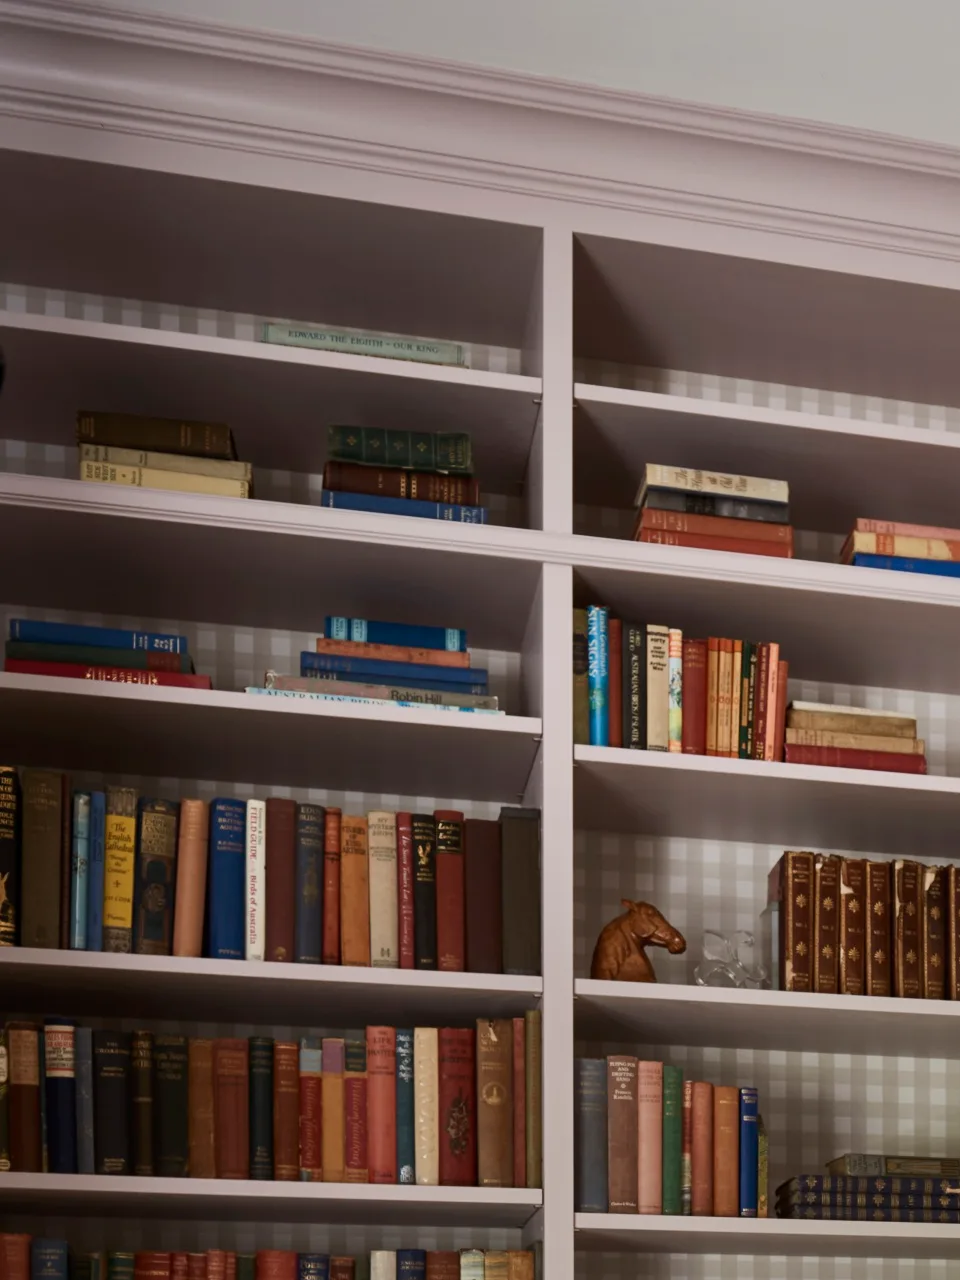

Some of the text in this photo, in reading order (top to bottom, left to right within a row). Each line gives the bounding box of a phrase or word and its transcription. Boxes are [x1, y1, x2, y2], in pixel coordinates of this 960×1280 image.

[287, 329, 440, 354] EDWARD THE EIGHTH OUR KING
[86, 463, 94, 479] EAST
[600, 609, 608, 633] Linda
[587, 608, 600, 678] SUN SIGNS
[630, 652, 640, 694] AUSTRALIAN
[390, 689, 444, 705] Robin Hill
[629, 694, 640, 713] BIRDS
[113, 822, 127, 833] The
[107, 833, 133, 845] English
[248, 807, 258, 945] FIELD GUIDE Birds of Australia
